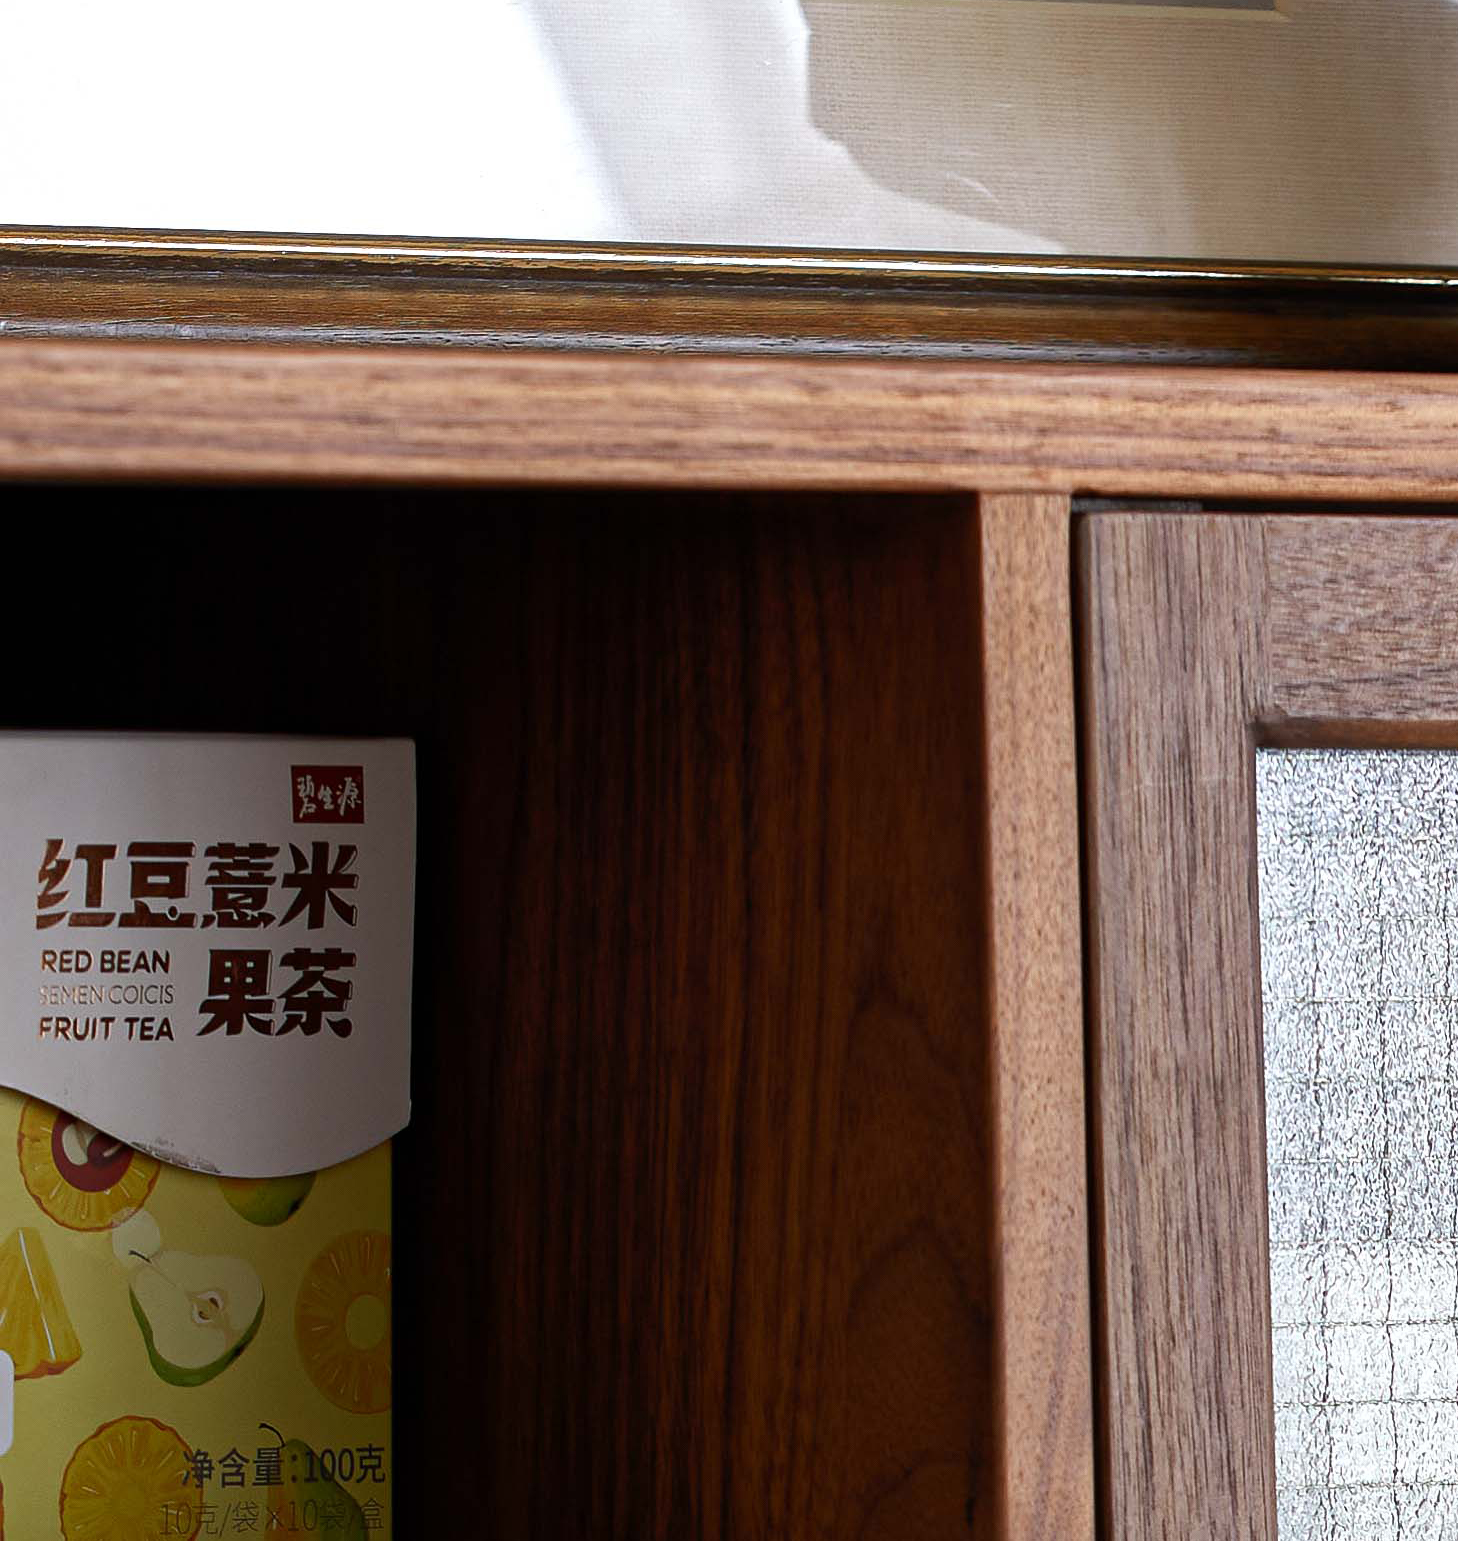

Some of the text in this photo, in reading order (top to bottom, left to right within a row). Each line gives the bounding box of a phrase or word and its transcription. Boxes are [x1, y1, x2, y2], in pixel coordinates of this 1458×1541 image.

[36, 838, 360, 931] 红豆薏米
[41, 949, 171, 974] RED BEAN
[39, 984, 175, 1006] SEMEN COICIS
[195, 947, 357, 1039] 果茶
[38, 1015, 175, 1042] FRUIT TEA
